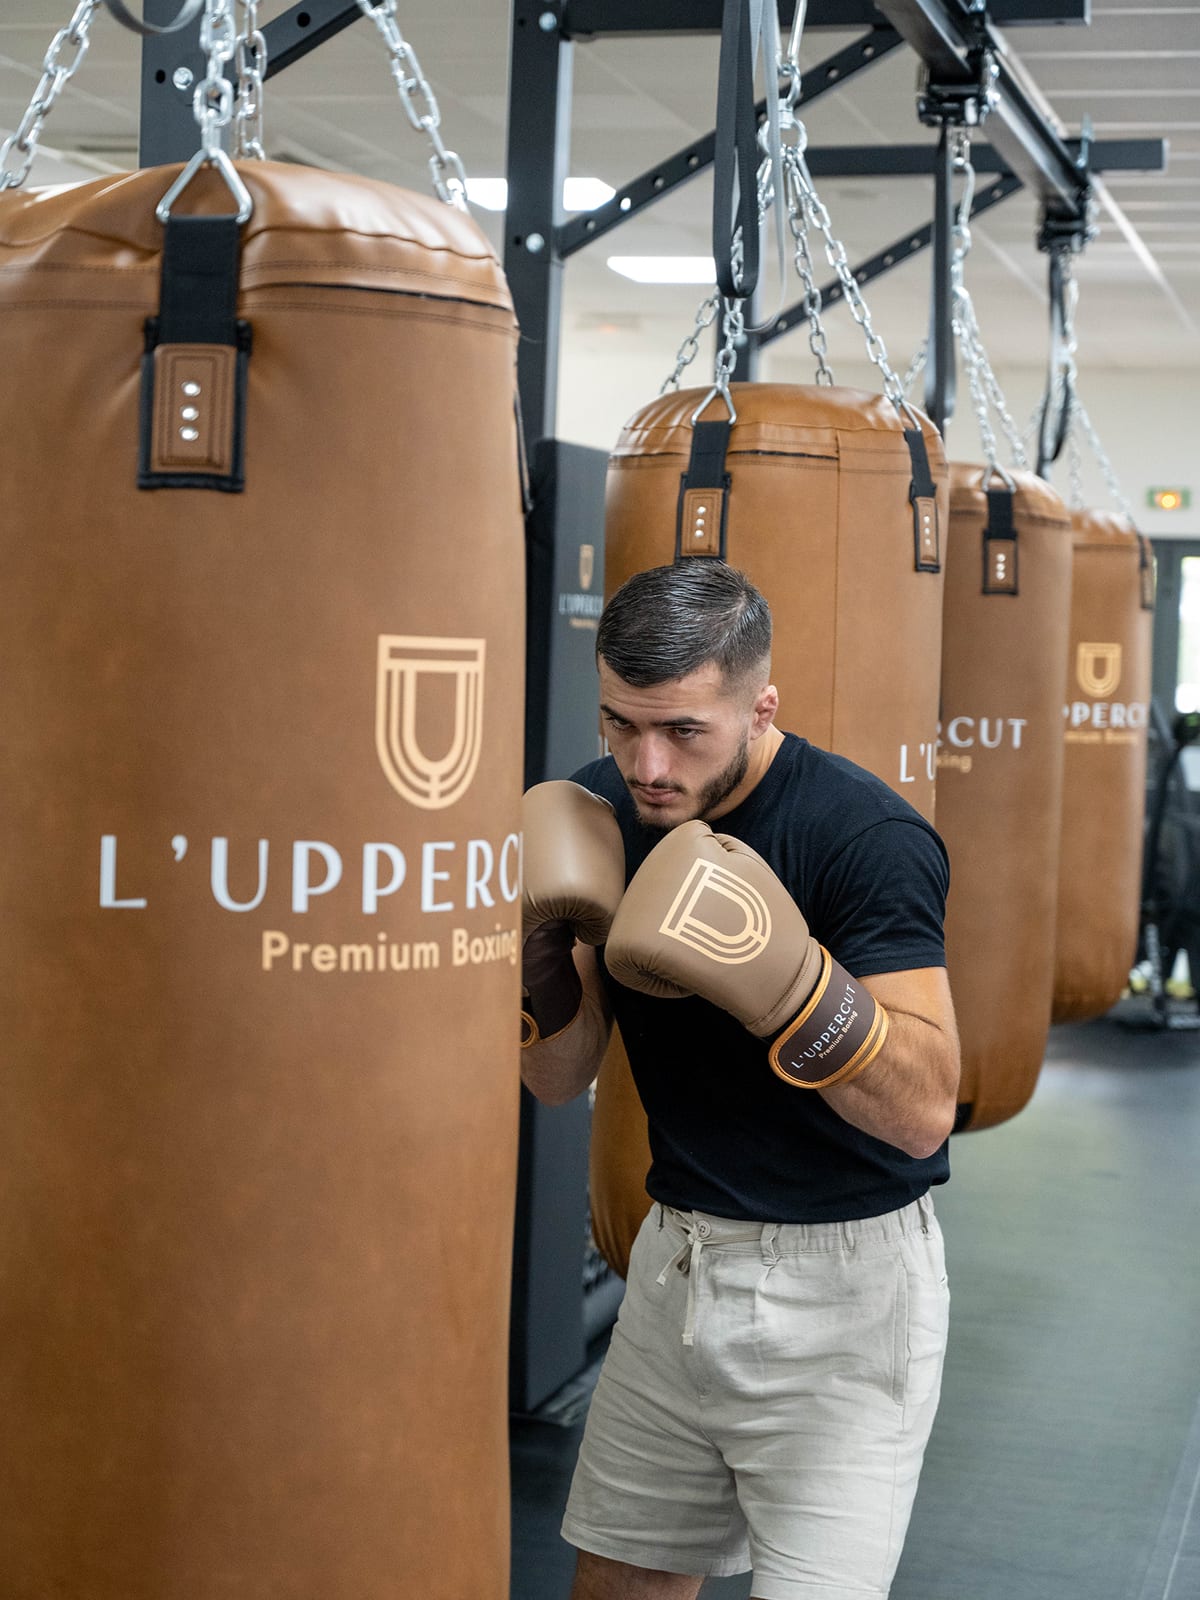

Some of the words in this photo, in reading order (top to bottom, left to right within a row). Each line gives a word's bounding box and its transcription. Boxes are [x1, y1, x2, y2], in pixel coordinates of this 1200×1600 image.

[100, 831, 523, 914] L'UPPERC
[262, 930, 439, 972] Premium
[452, 923, 517, 966] Boxing
[791, 984, 856, 1069] L'UPPERCUT
[818, 1033, 844, 1059] Premium
[841, 1010, 859, 1034] Boxing
